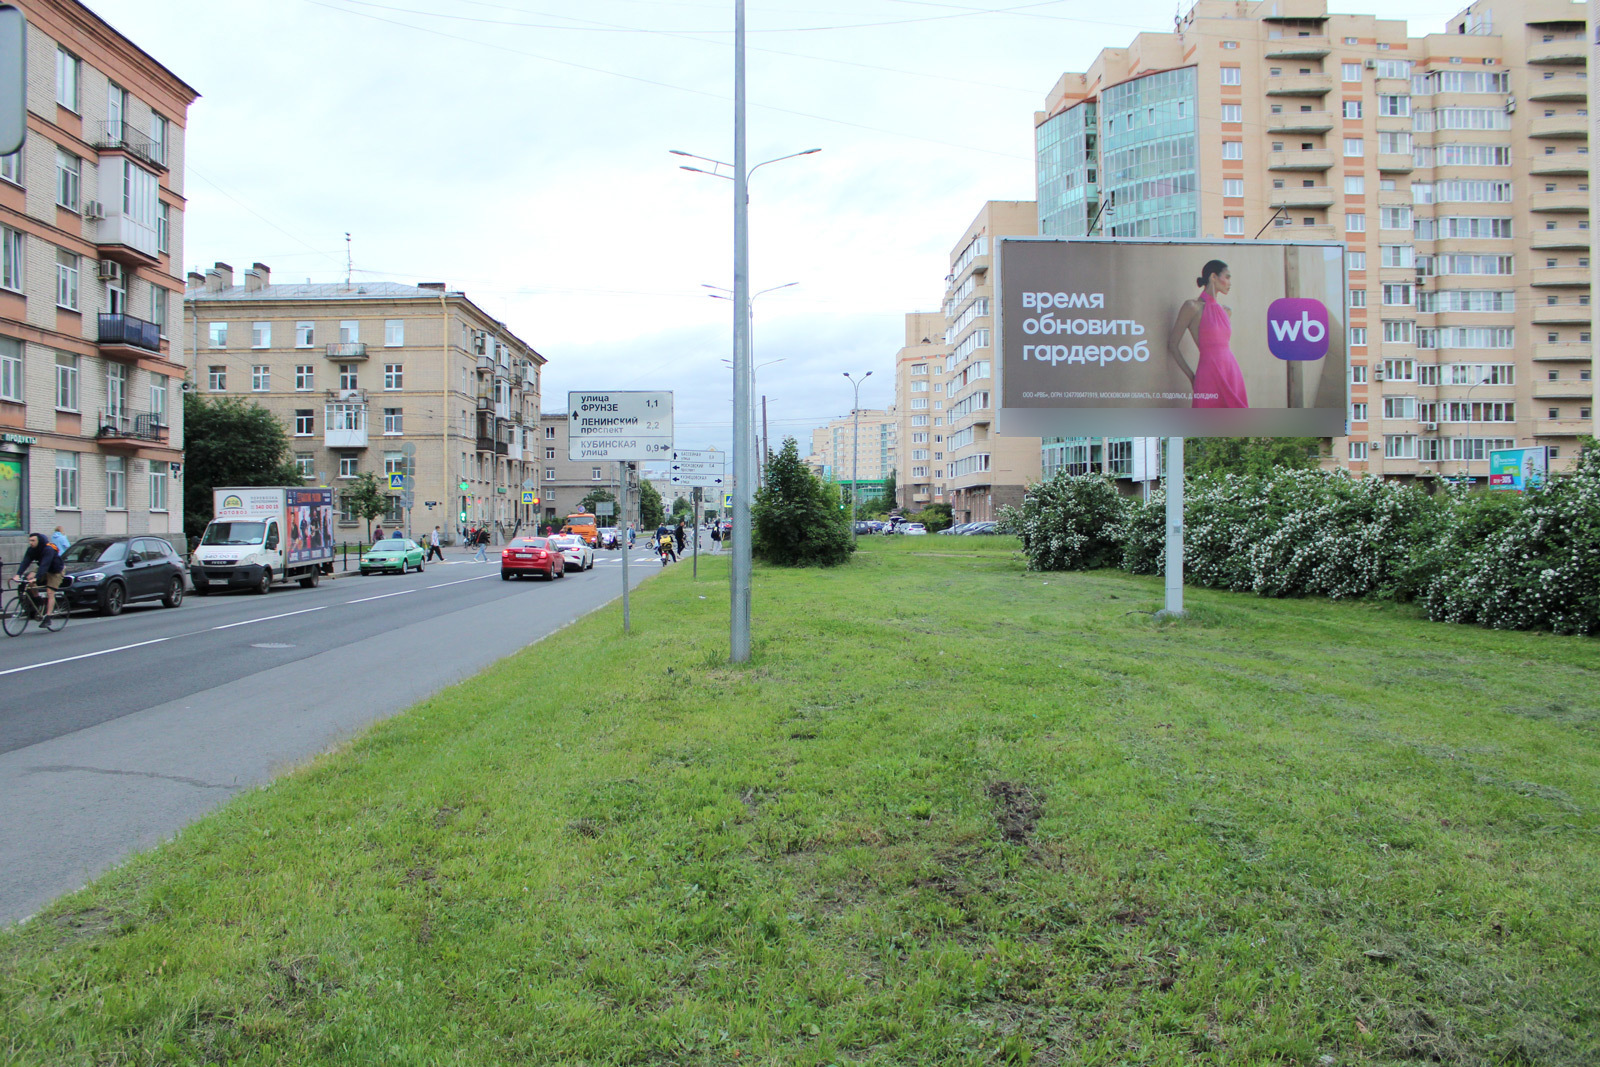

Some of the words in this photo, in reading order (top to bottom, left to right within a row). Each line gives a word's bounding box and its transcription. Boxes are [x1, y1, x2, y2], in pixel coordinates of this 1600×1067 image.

[1022, 292, 1104, 314] время
[1022, 312, 1145, 335] обновить
[1270, 310, 1326, 343] wb
[1022, 339, 1150, 367] гардероб
[581, 395, 609, 404] улица
[646, 399, 658, 408] 1,1
[581, 403, 619, 411] ФРУНЗЕ
[581, 417, 638, 426] ЛЕНИНСКИЙ
[646, 421, 660, 430] 2,2
[580, 427, 624, 435] проспект
[5, 433, 38, 444] ПРОДУКТЫ
[580, 440, 637, 448] КУБИНСКАЯ
[645, 444, 660, 453] 0,9
[581, 449, 608, 458] улица
